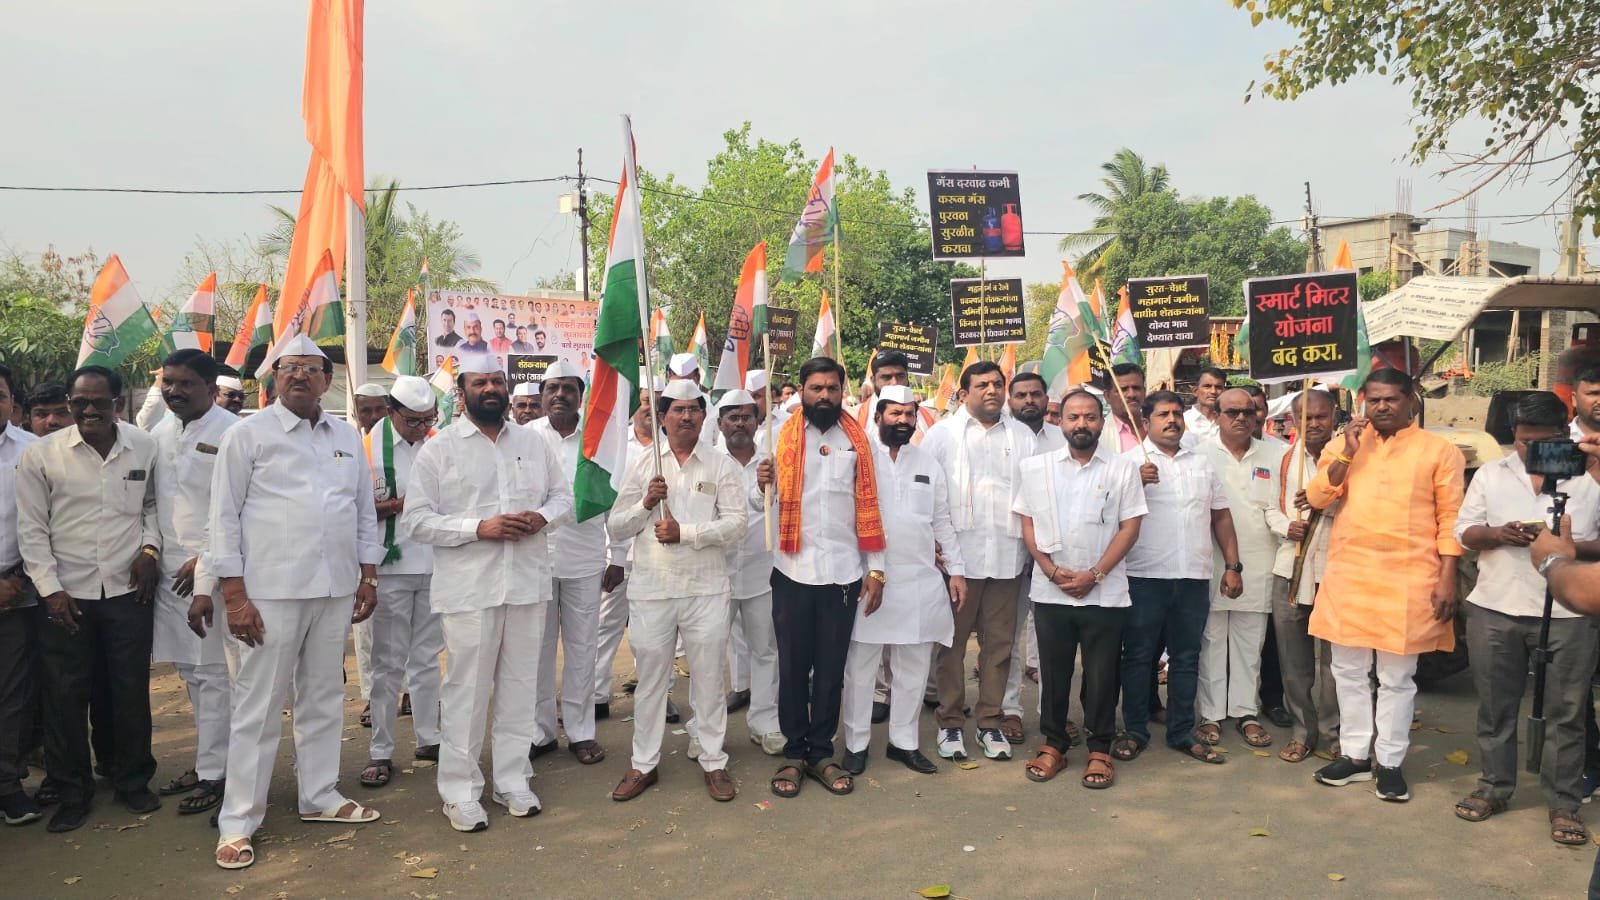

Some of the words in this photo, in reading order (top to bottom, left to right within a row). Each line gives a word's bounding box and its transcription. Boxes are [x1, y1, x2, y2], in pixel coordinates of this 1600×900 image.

[936, 176, 954, 187] गॅस
[957, 179, 986, 188] दरवाढ
[989, 177, 1010, 188] कमी
[968, 193, 986, 204] गॅस
[940, 212, 968, 224] पुरवठा
[941, 225, 974, 240] सुरळीत
[942, 244, 971, 253] करावा
[1138, 294, 1171, 306] महामार्ग
[1173, 293, 1199, 303] जमीन
[1255, 283, 1301, 312] स्मार्ट
[1305, 281, 1349, 308] मिटर
[1133, 307, 1157, 318] बाधीत
[1148, 320, 1169, 329] योग्य
[1172, 320, 1188, 328] भाव
[1274, 313, 1333, 337] योजना
[1147, 333, 1173, 342] देण्यात
[1175, 332, 1193, 340] यावा
[1271, 340, 1298, 366] बंद
[1301, 343, 1343, 362] करा.
